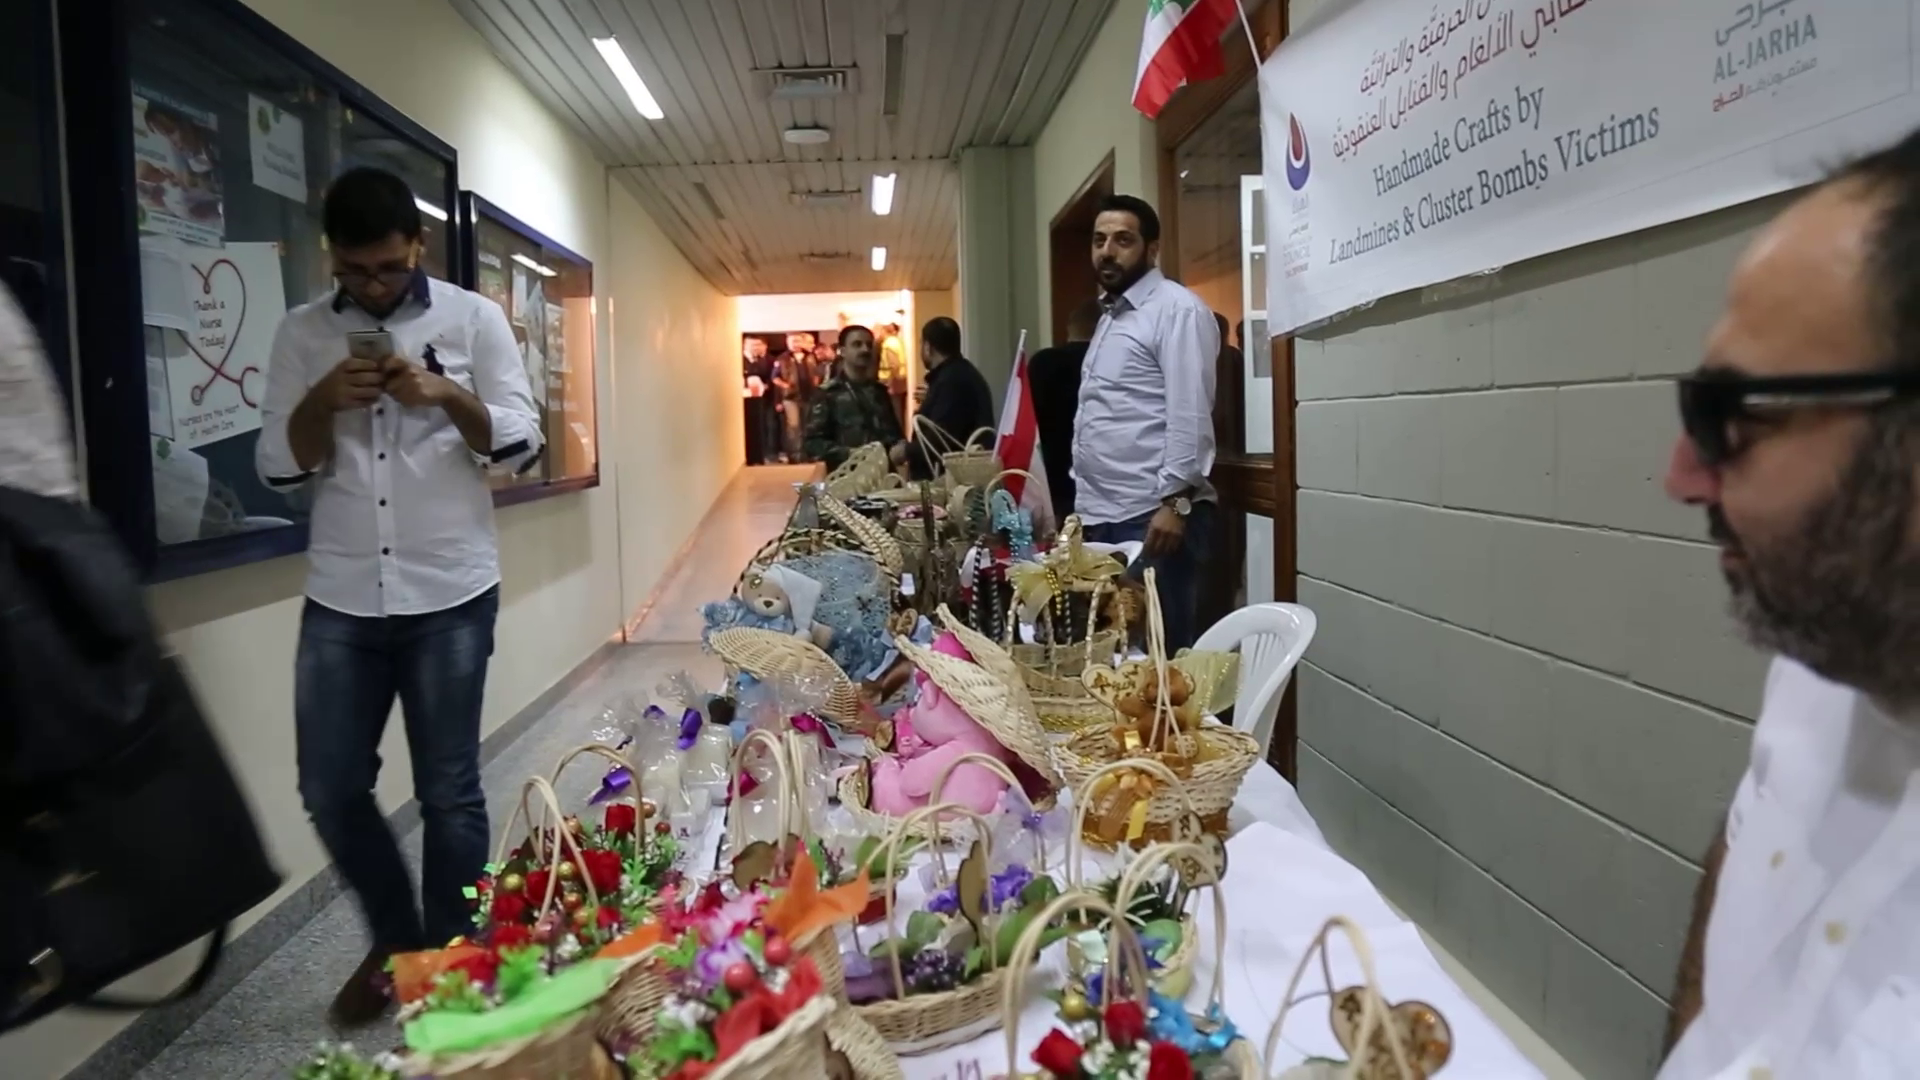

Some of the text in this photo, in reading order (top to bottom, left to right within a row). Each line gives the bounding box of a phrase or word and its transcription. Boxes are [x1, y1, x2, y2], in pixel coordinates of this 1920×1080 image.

[1712, 14, 1818, 84] AL-JARHA
[1329, 221, 1400, 265] Landmines
[1402, 205, 1416, 237] &
[1417, 185, 1475, 230] Cluster
[1477, 148, 1549, 206] Bombs
[1553, 106, 1660, 172] Victims
[1372, 85, 1545, 197] Handmade Crafts by
